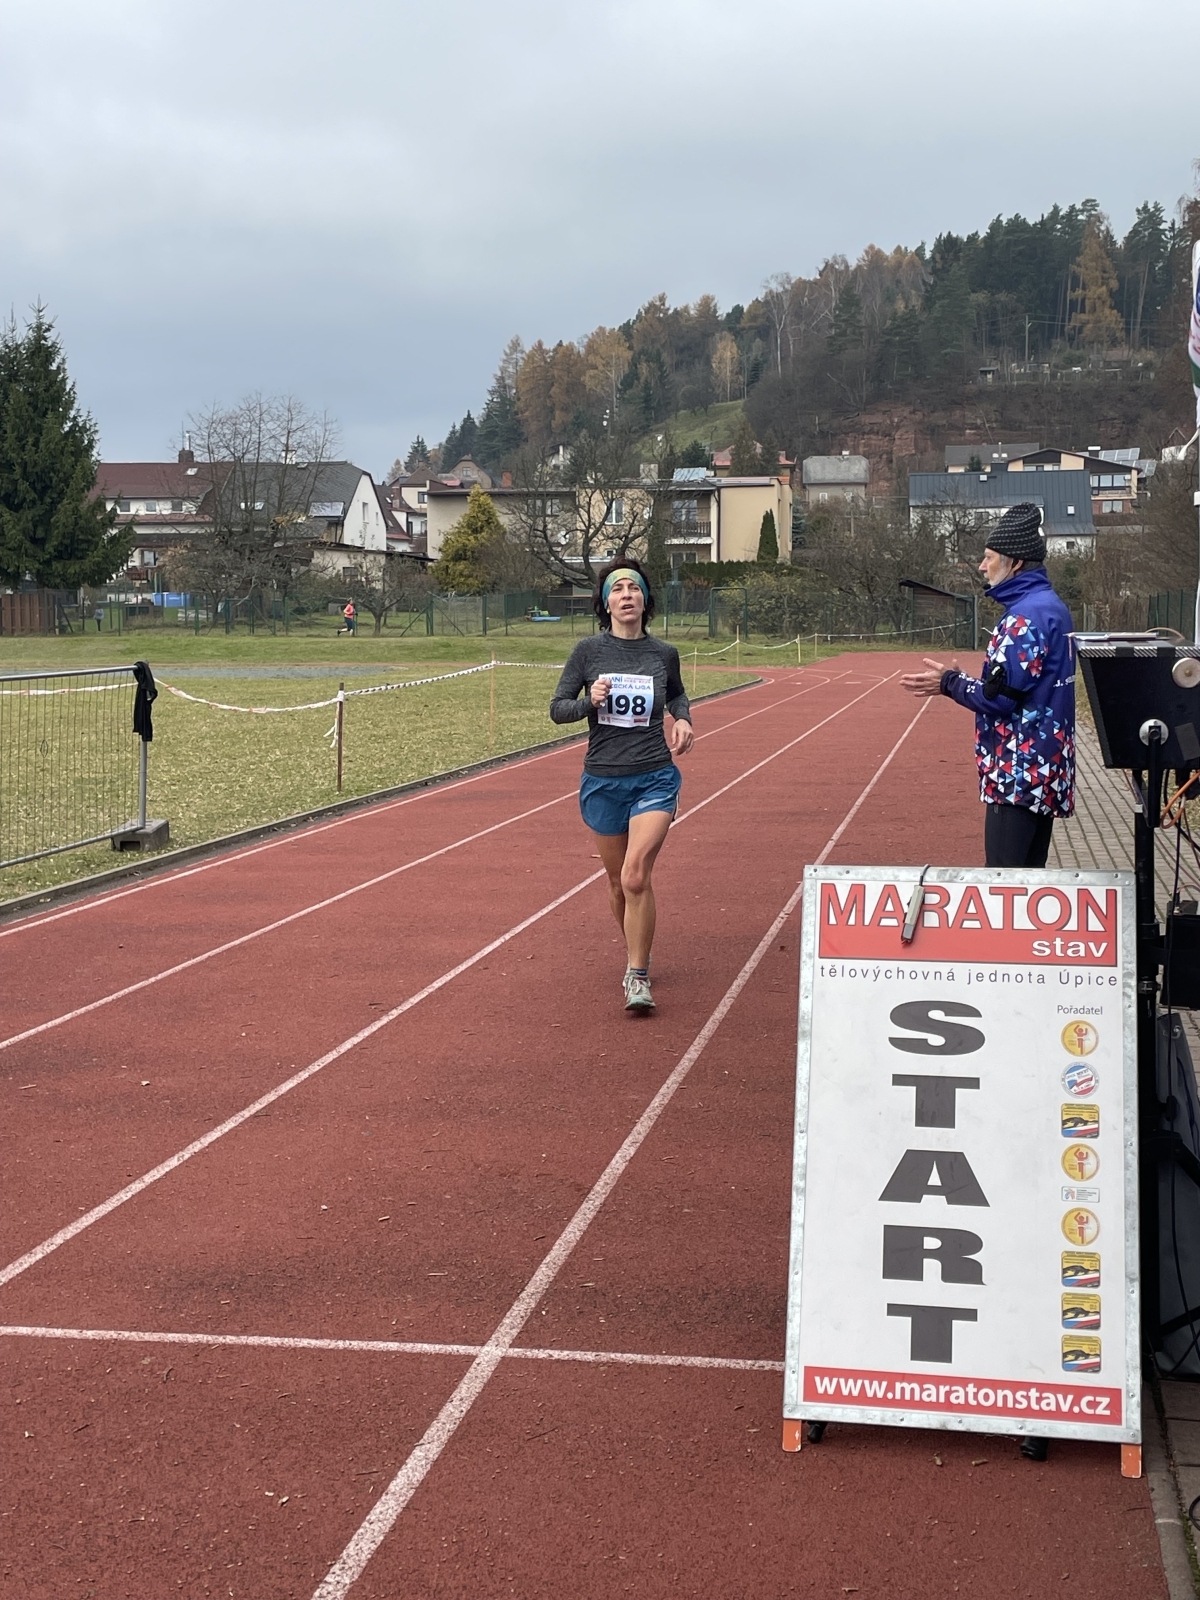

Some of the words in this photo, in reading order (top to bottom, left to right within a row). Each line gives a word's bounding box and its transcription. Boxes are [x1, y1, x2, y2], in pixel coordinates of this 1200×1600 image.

[607, 694, 647, 716] 198
[820, 882, 1118, 932] MARATON
[1031, 936, 1109, 958] stav
[820, 964, 956, 982] tělovýchovná
[967, 968, 1046, 985] jednota
[1059, 968, 1118, 988] Úpice
[1057, 1004, 1104, 1016] Pořadatel
[877, 999, 991, 1365] START
[813, 1375, 1112, 1417] www.maratonstav.cz
